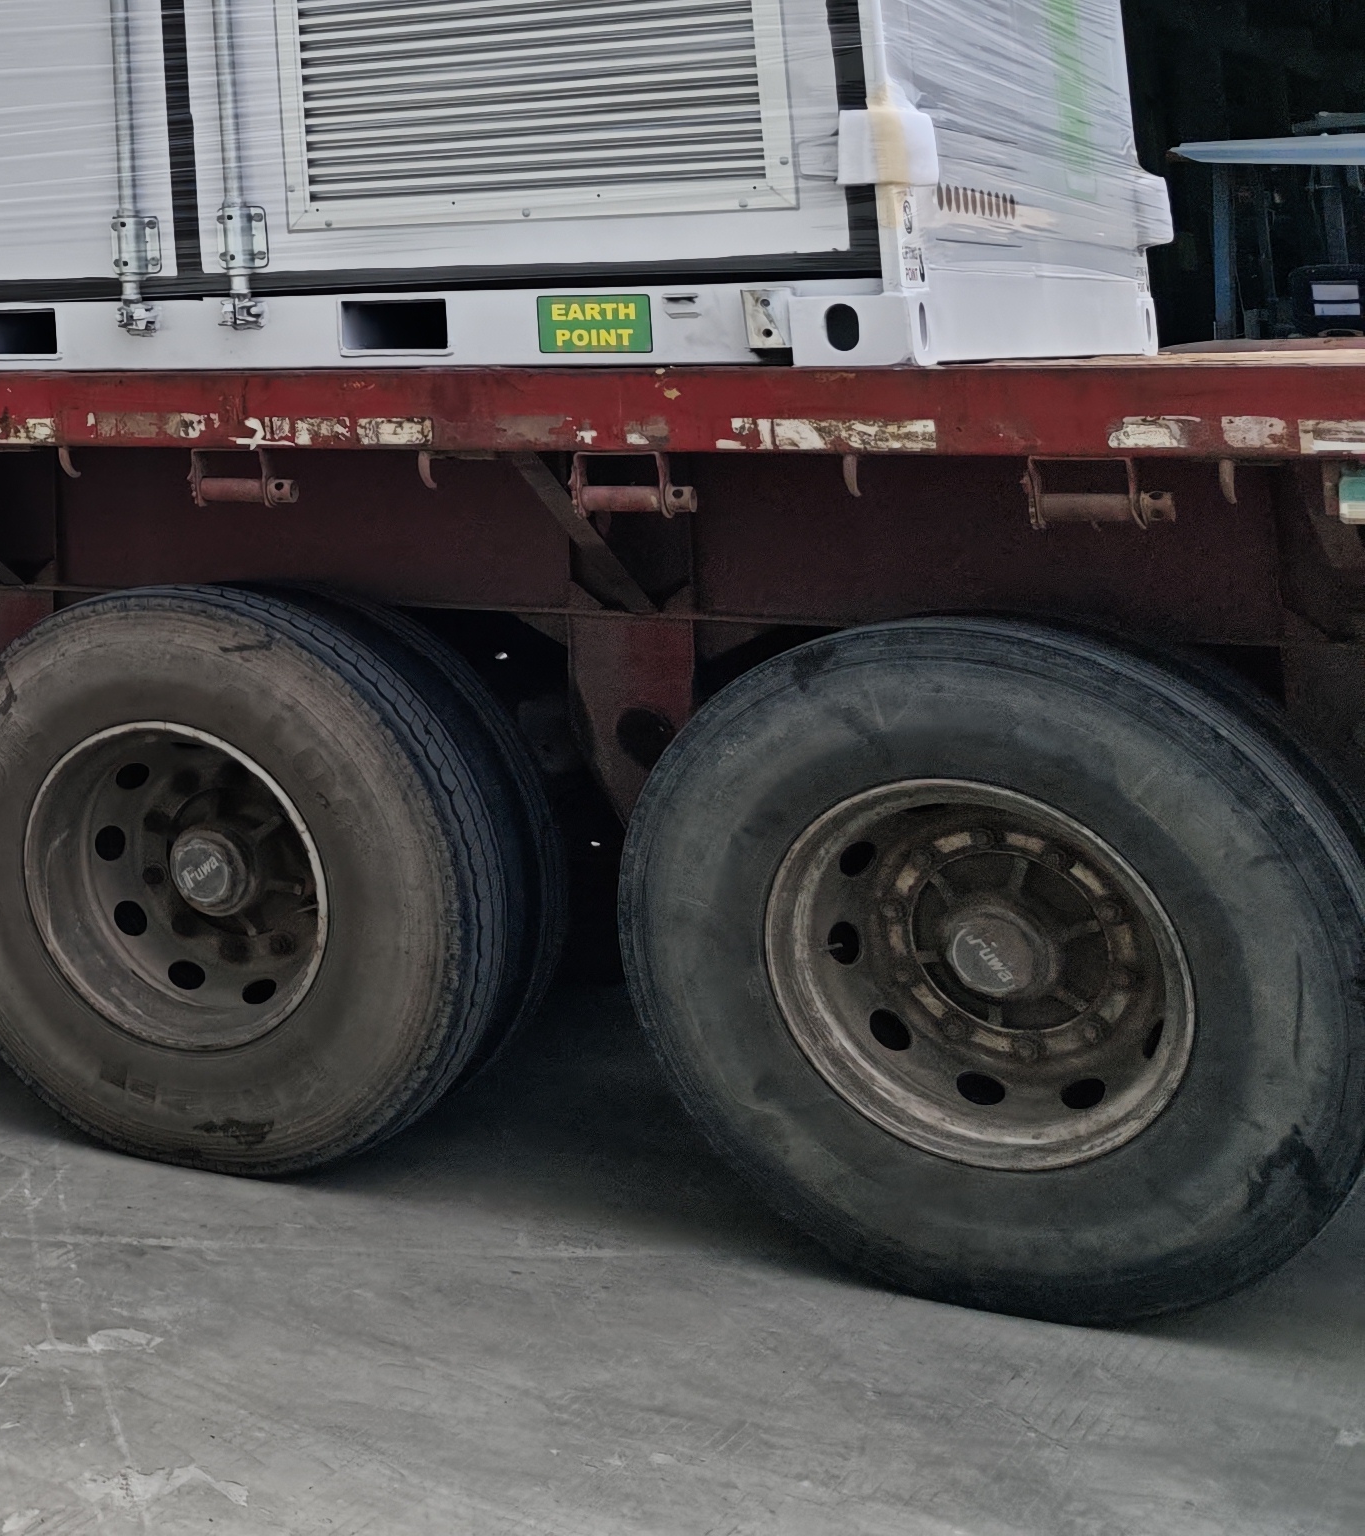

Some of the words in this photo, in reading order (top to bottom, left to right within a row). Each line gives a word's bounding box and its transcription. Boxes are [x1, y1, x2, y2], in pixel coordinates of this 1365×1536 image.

[551, 303, 636, 320] EARTH
[555, 329, 633, 346] POINT
[181, 855, 219, 890] Fuwa
